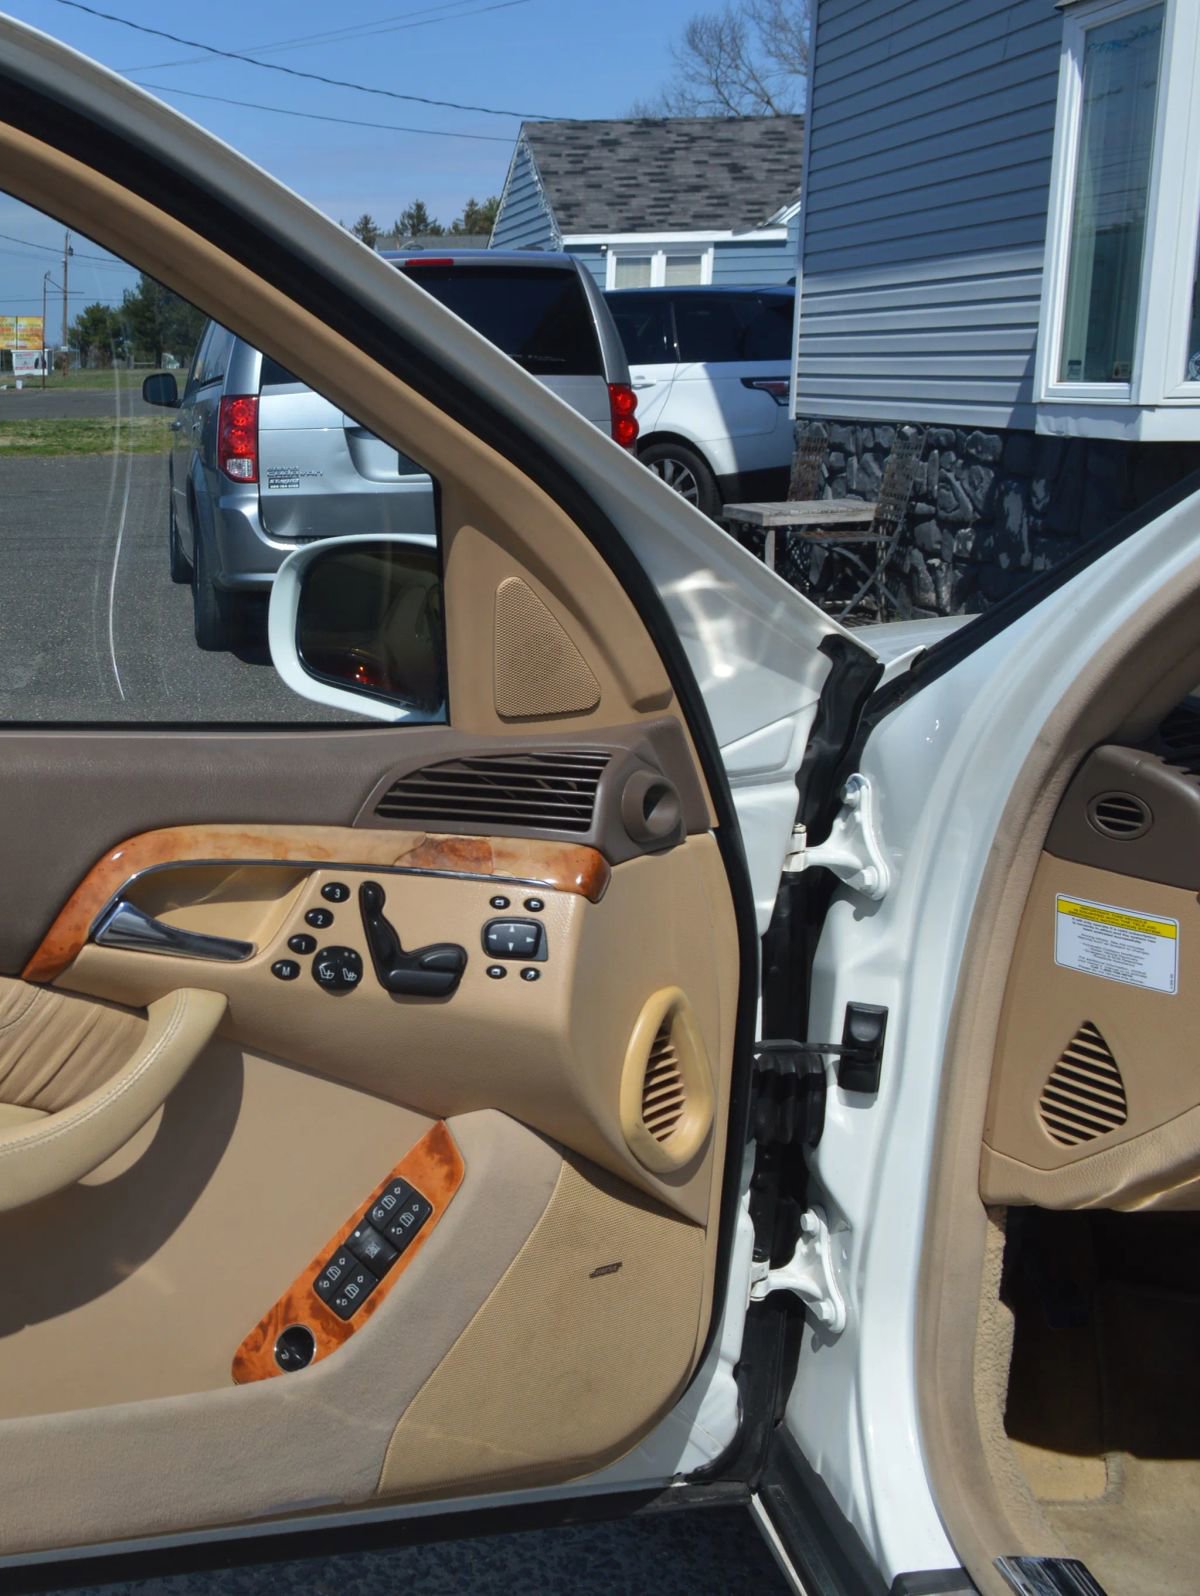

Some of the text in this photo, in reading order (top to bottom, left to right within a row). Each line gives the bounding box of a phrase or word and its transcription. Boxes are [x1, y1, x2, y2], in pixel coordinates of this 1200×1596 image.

[334, 888, 341, 899] 3
[316, 914, 324, 925] 2
[282, 966, 291, 976] M
